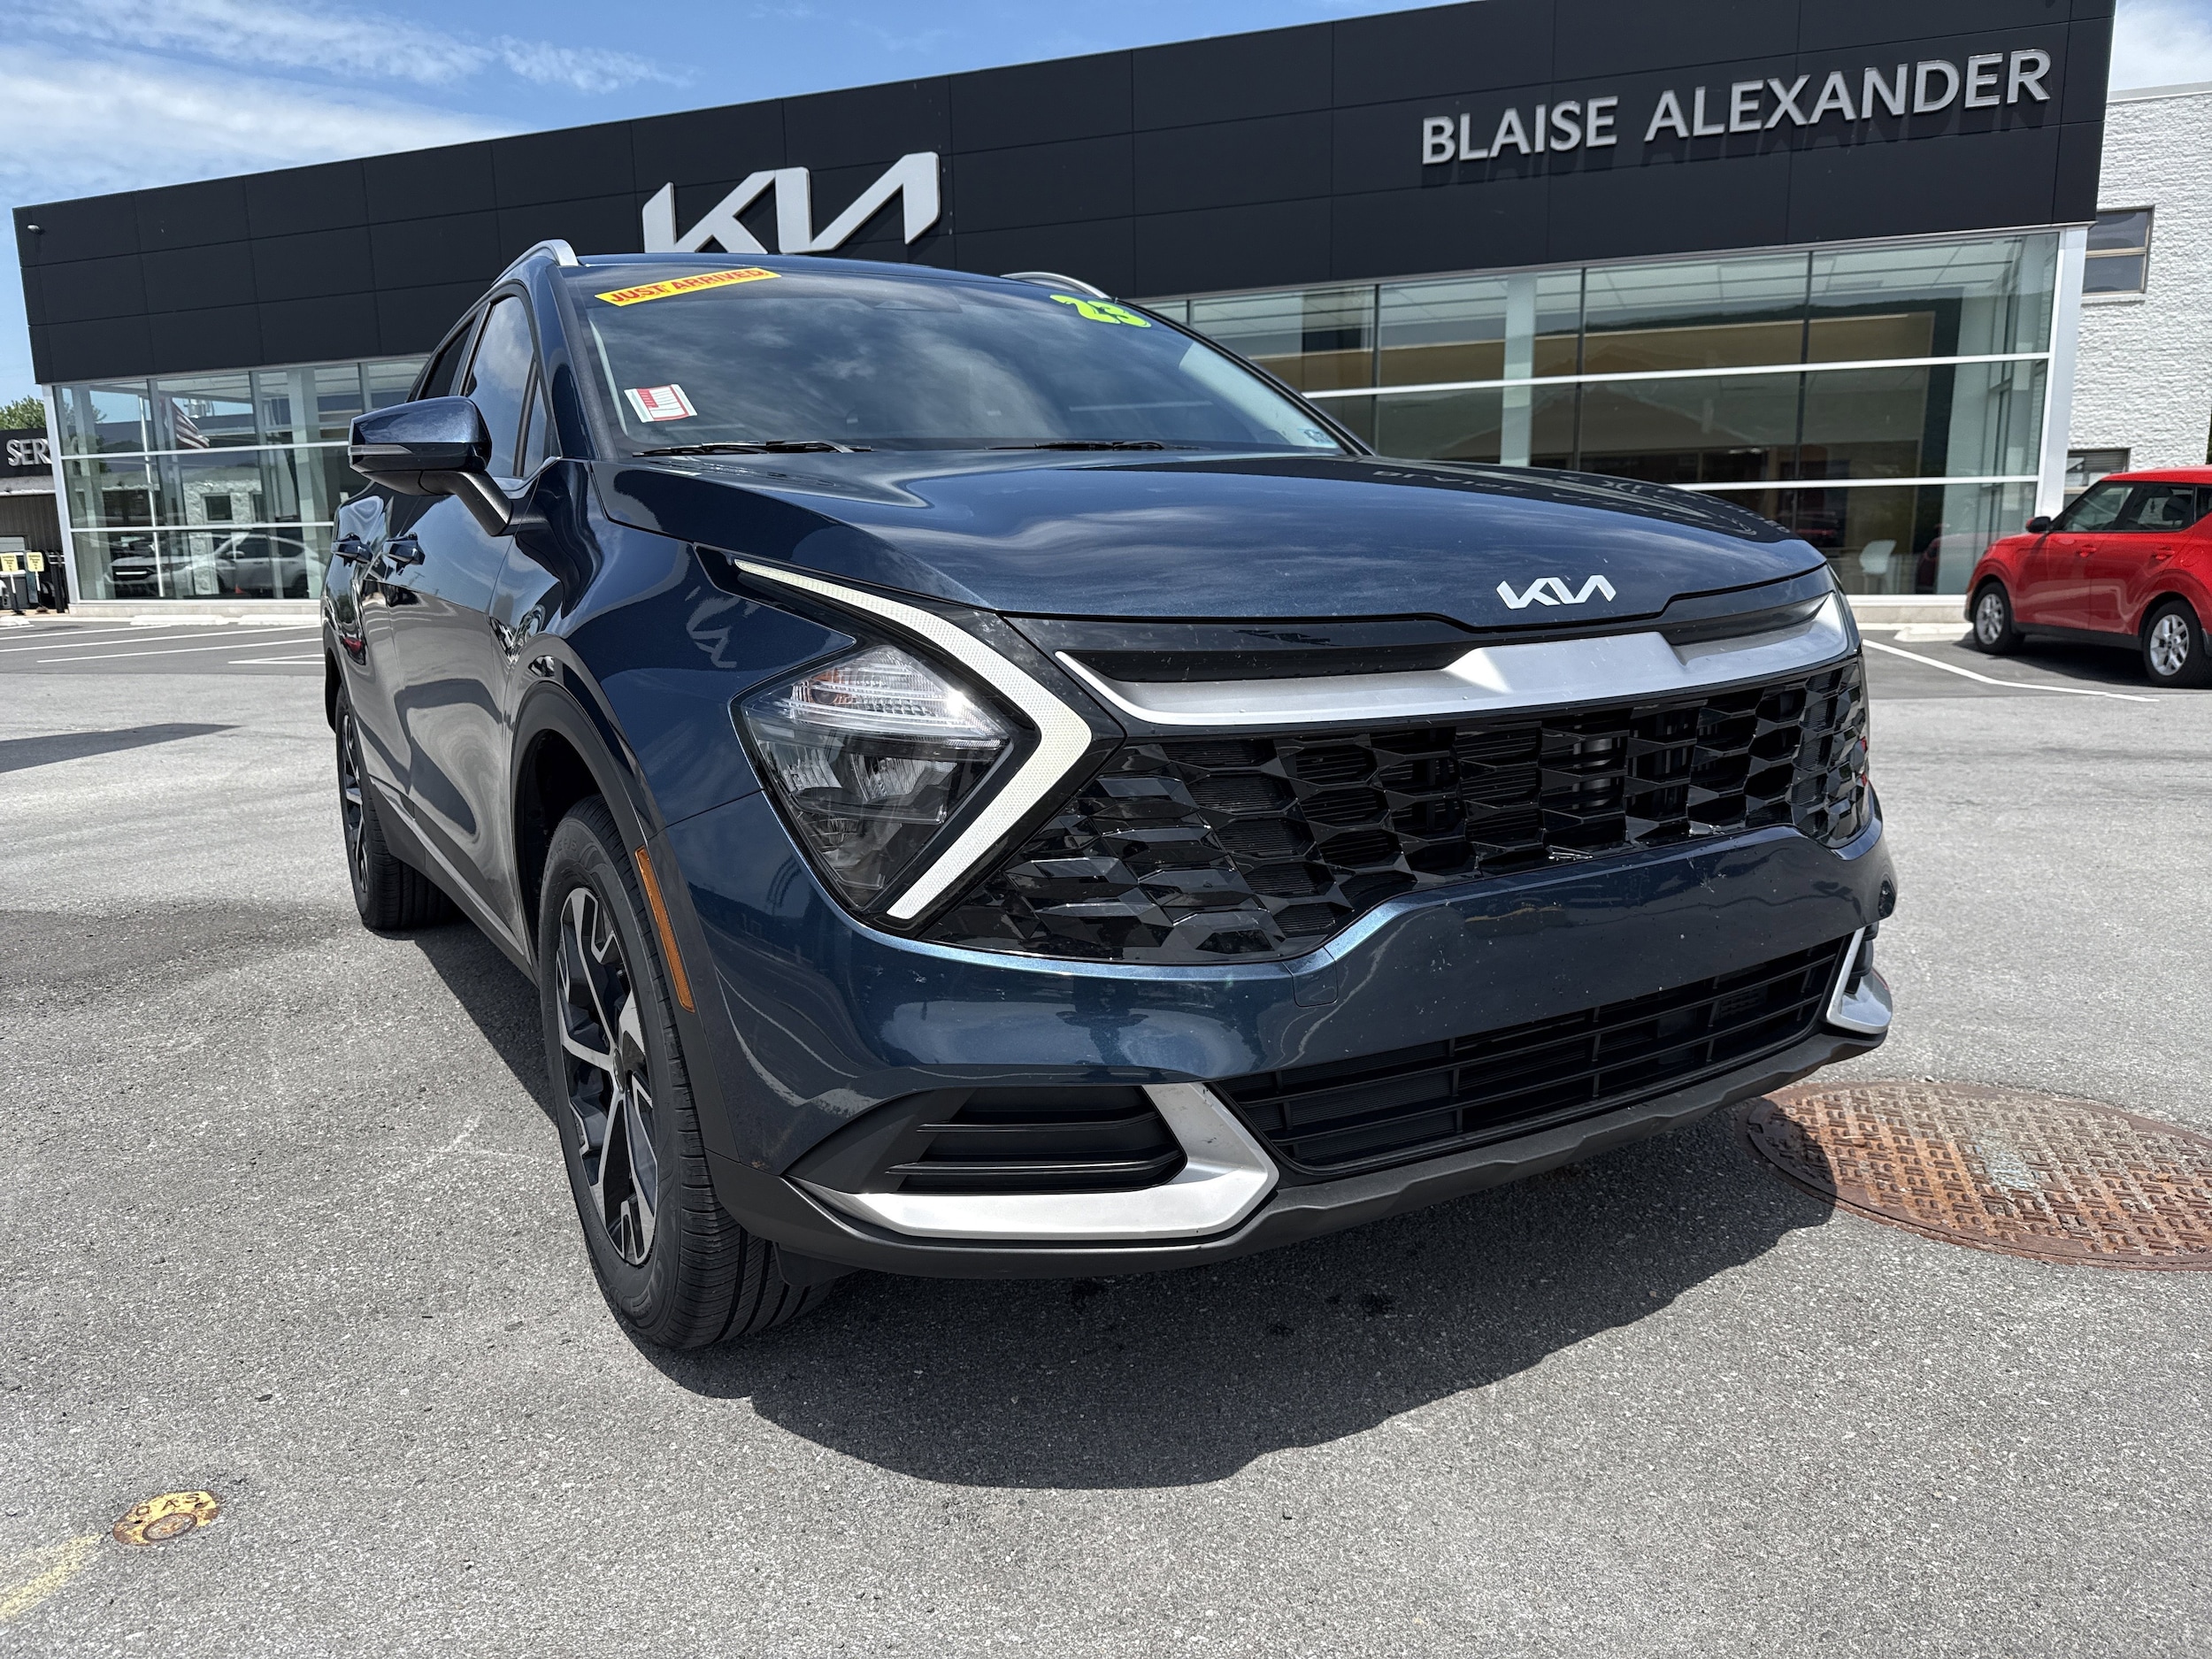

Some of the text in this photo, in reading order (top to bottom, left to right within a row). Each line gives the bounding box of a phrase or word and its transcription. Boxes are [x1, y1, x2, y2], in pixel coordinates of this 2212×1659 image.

[1421, 48, 2052, 166] BLAISE ALEXANDER
[641, 150, 941, 256] KIA
[610, 268, 771, 303] JUST ARRIVED
[1496, 574, 1617, 610] KIA
